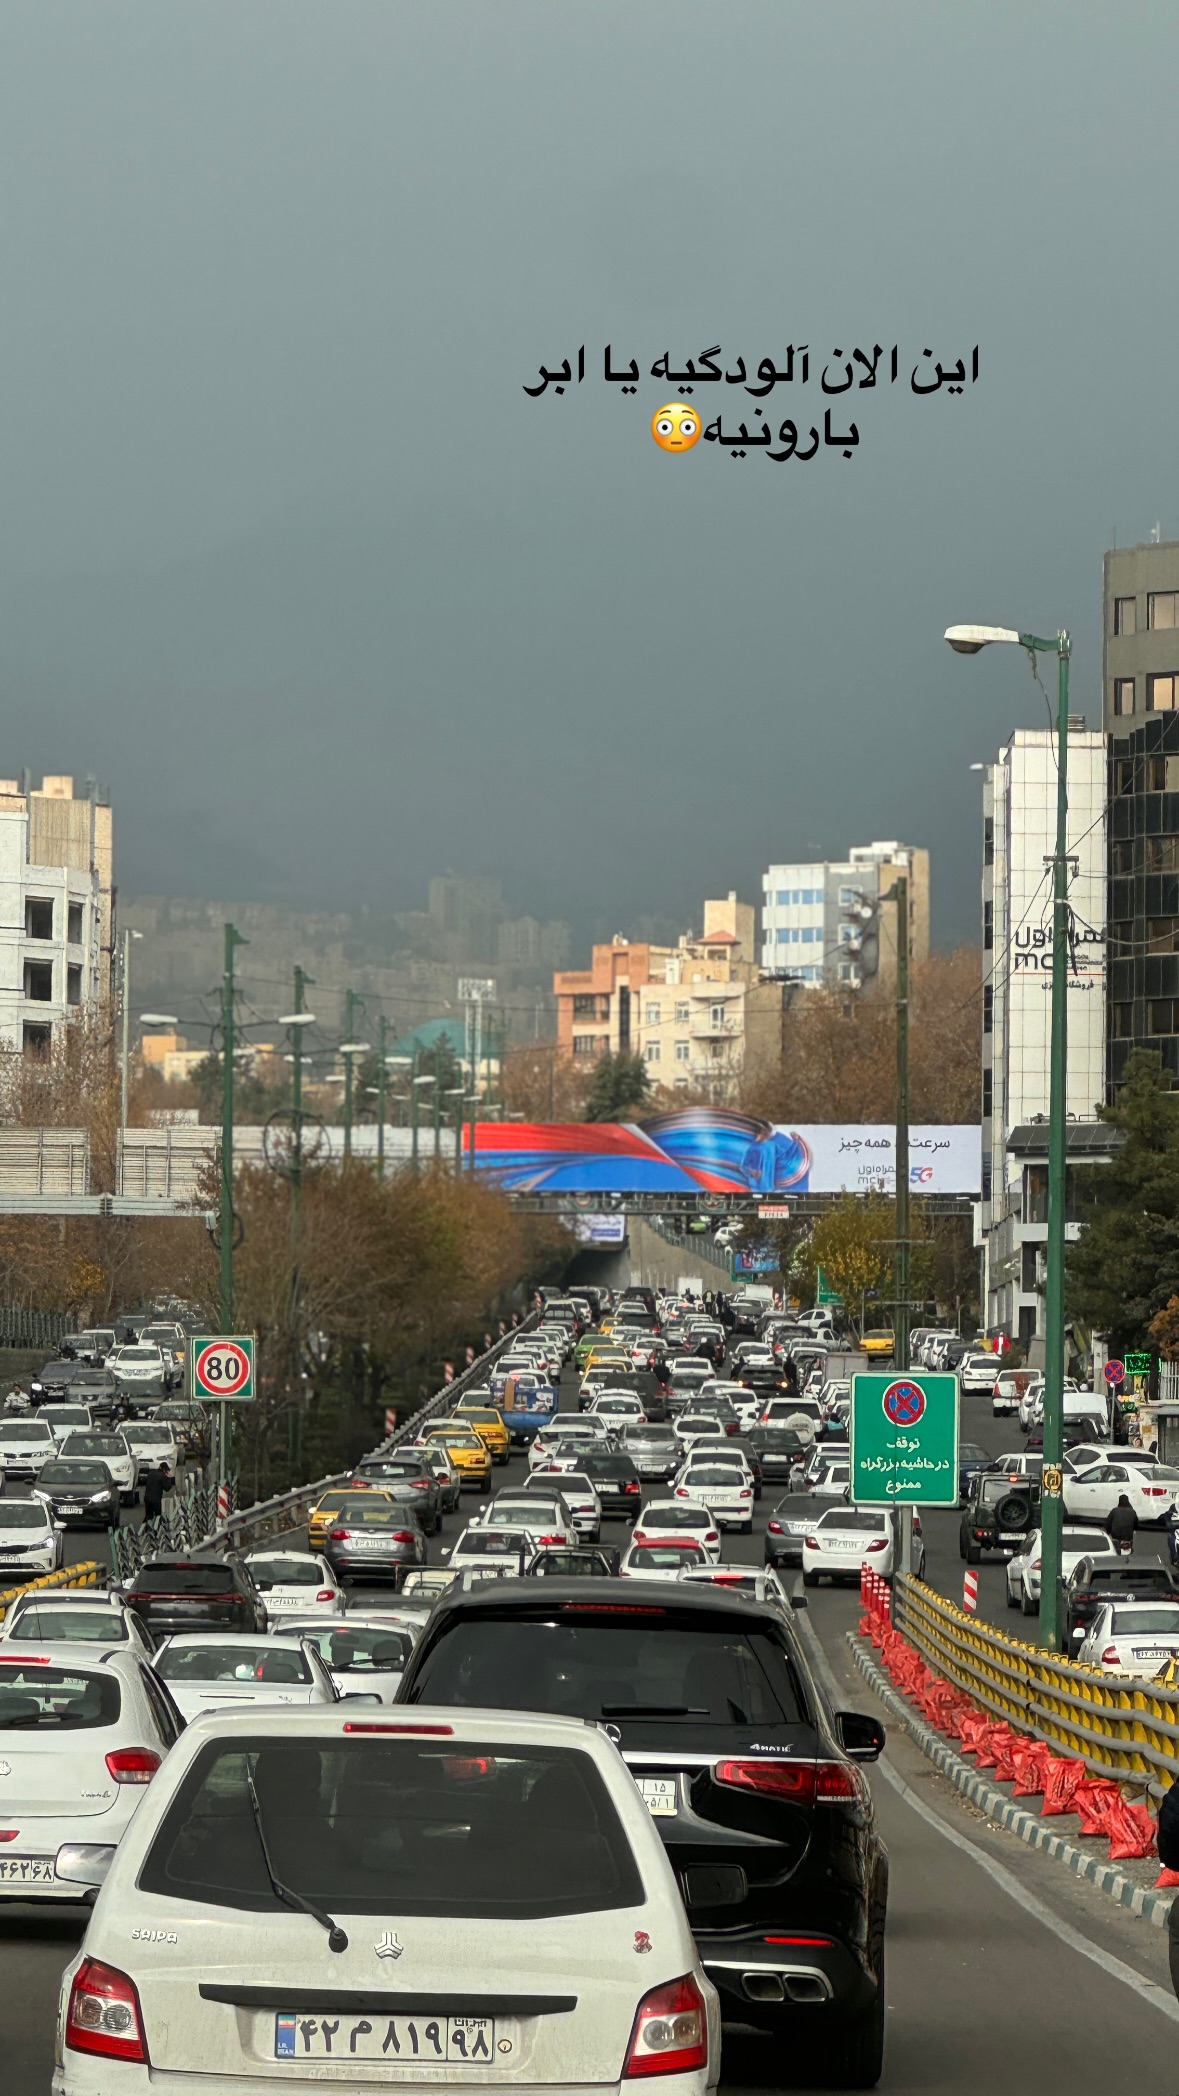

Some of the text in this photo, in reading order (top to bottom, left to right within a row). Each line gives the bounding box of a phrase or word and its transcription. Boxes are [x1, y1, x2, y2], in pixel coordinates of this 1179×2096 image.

[908, 1138, 951, 1153] سرعت
[909, 1166, 933, 1184] 5G
[206, 1356, 241, 1381] 80
[886, 1436, 921, 1453] توقف
[901, 1456, 935, 1471] حاشیه
[934, 1459, 950, 1472] در
[885, 1478, 922, 1494] ممنوع
[131, 1928, 178, 1944] SAIPA
[382, 2020, 443, 2055] ۸۱۹
[451, 2029, 490, 2058] ۹۸
